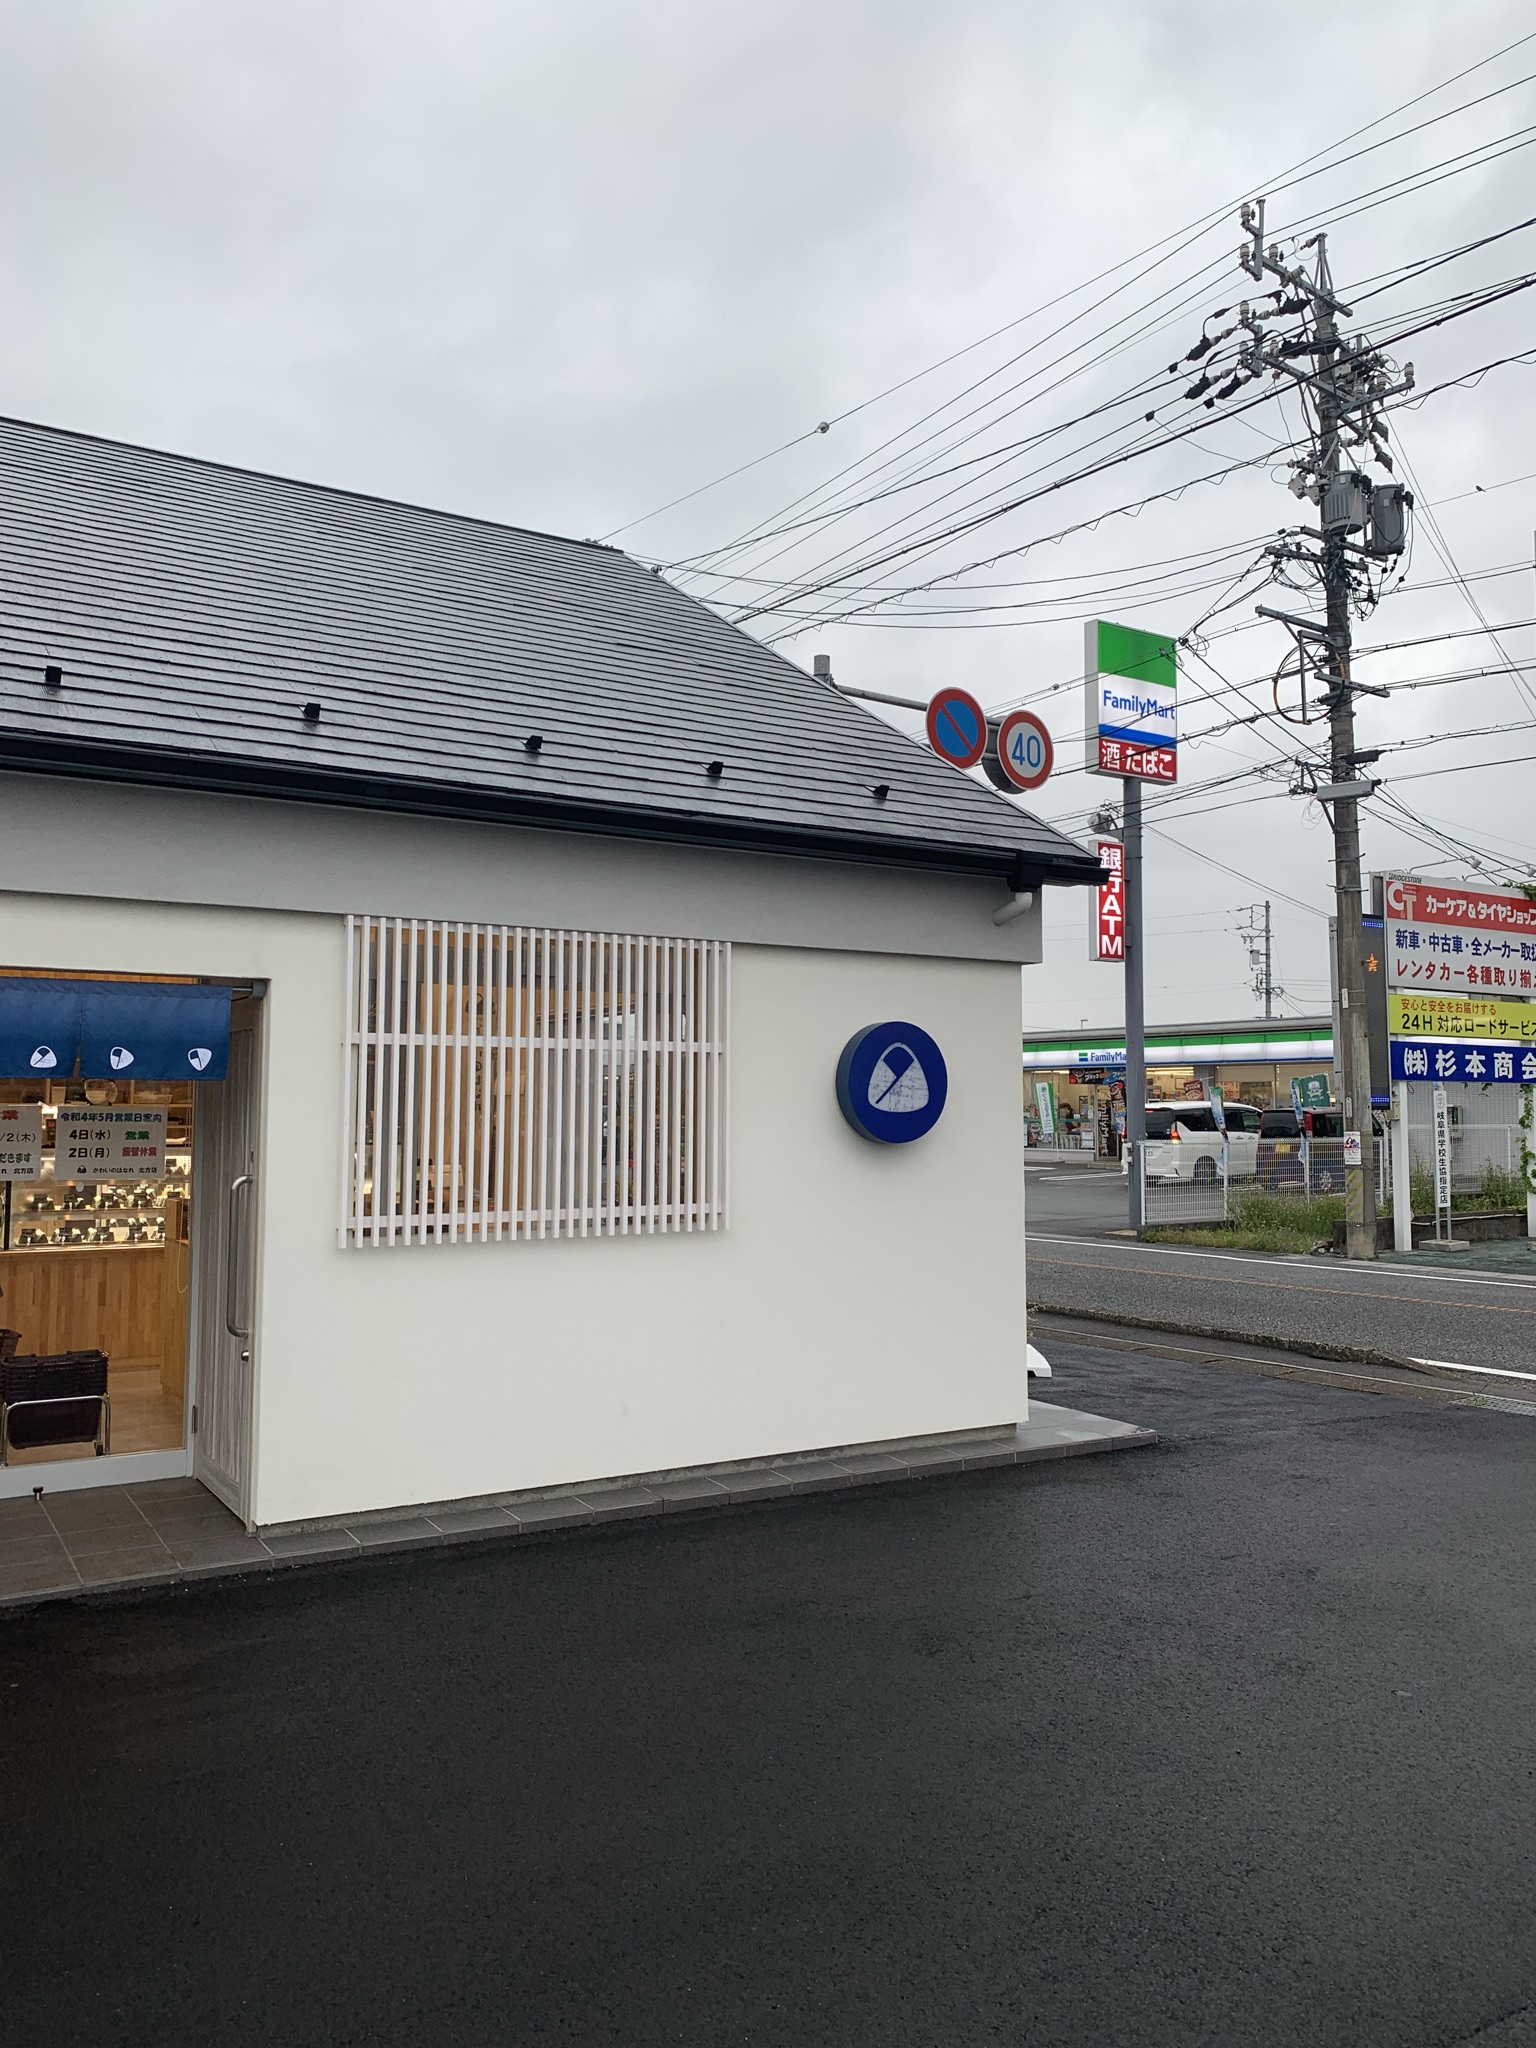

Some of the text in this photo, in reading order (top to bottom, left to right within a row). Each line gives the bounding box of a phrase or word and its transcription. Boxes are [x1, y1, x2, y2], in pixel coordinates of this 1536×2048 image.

[1103, 690, 1175, 721] FamilyMart
[1011, 732, 1041, 768] 40
[1389, 873, 1422, 884] BRIDGESTONE
[1397, 959, 1536, 988] レンタカー各種取り揃
[1401, 998, 1496, 1015] 安心と安全をお届けする
[1402, 1013, 1433, 1031] 24H
[61, 1112, 162, 1123] 令和4年5月営業日案内
[69, 1130, 150, 1141] 4日(水) 営業
[68, 1148, 110, 1159] 2日(月)
